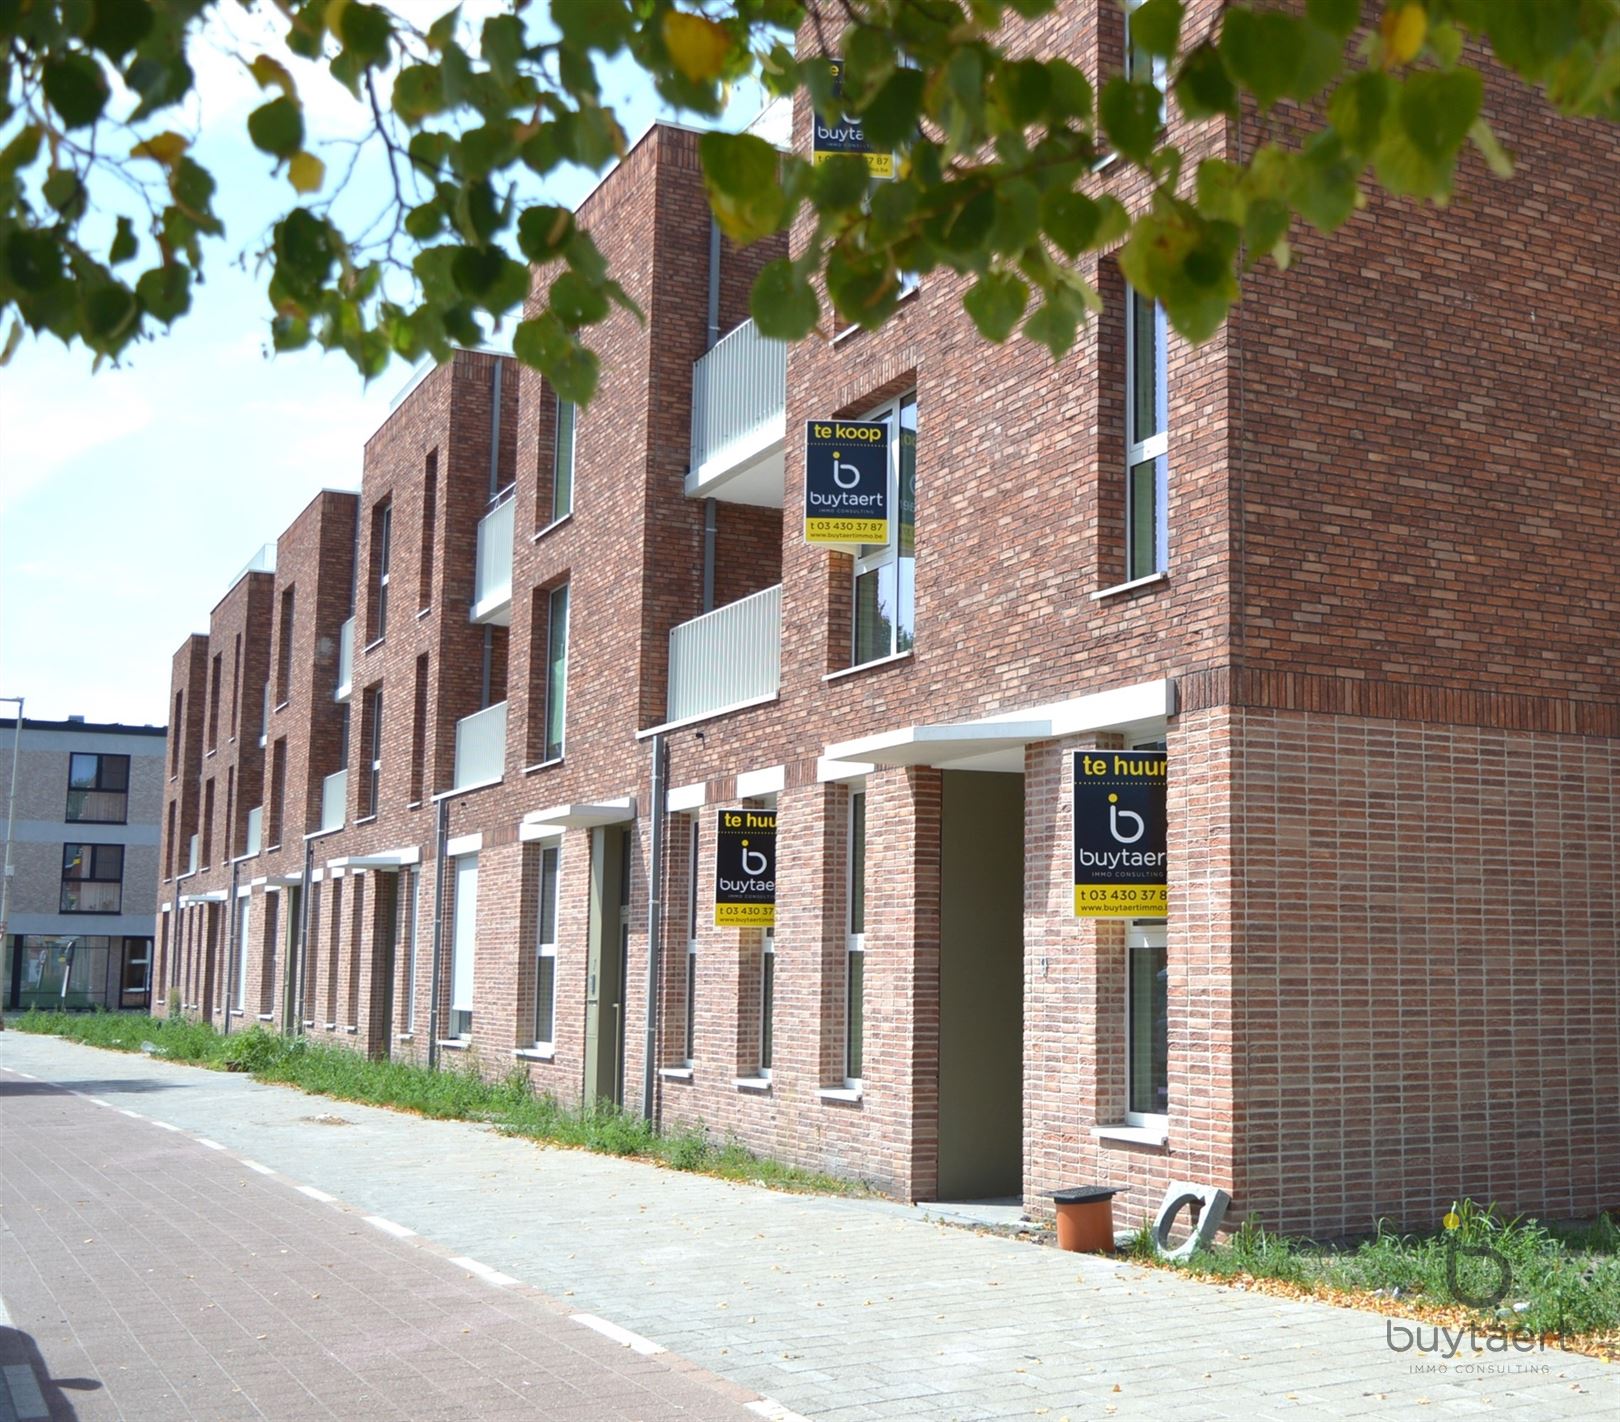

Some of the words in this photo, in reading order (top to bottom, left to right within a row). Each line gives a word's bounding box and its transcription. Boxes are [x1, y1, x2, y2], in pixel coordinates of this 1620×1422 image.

[817, 126, 864, 142] buyta
[814, 424, 832, 438] te
[835, 424, 882, 443] koop
[810, 491, 884, 508] buytaert
[817, 522, 831, 530] 03
[833, 522, 854, 531] 430
[856, 523, 868, 532] 37
[870, 523, 883, 532] 87
[1083, 755, 1107, 775] te
[1114, 755, 1167, 776] huur
[724, 812, 742, 828] te
[747, 813, 777, 828] huu
[1080, 848, 1166, 869] buytaer
[719, 877, 775, 893] buytae
[1081, 890, 1086, 900] t
[1089, 890, 1107, 900] 03
[1111, 890, 1136, 901] 430
[1141, 890, 1156, 900] 37
[1160, 890, 1168, 900] 8
[741, 907, 760, 915] 430
[762, 907, 774, 915] 37
[1080, 904, 1168, 912] www.buytaertimmo.
